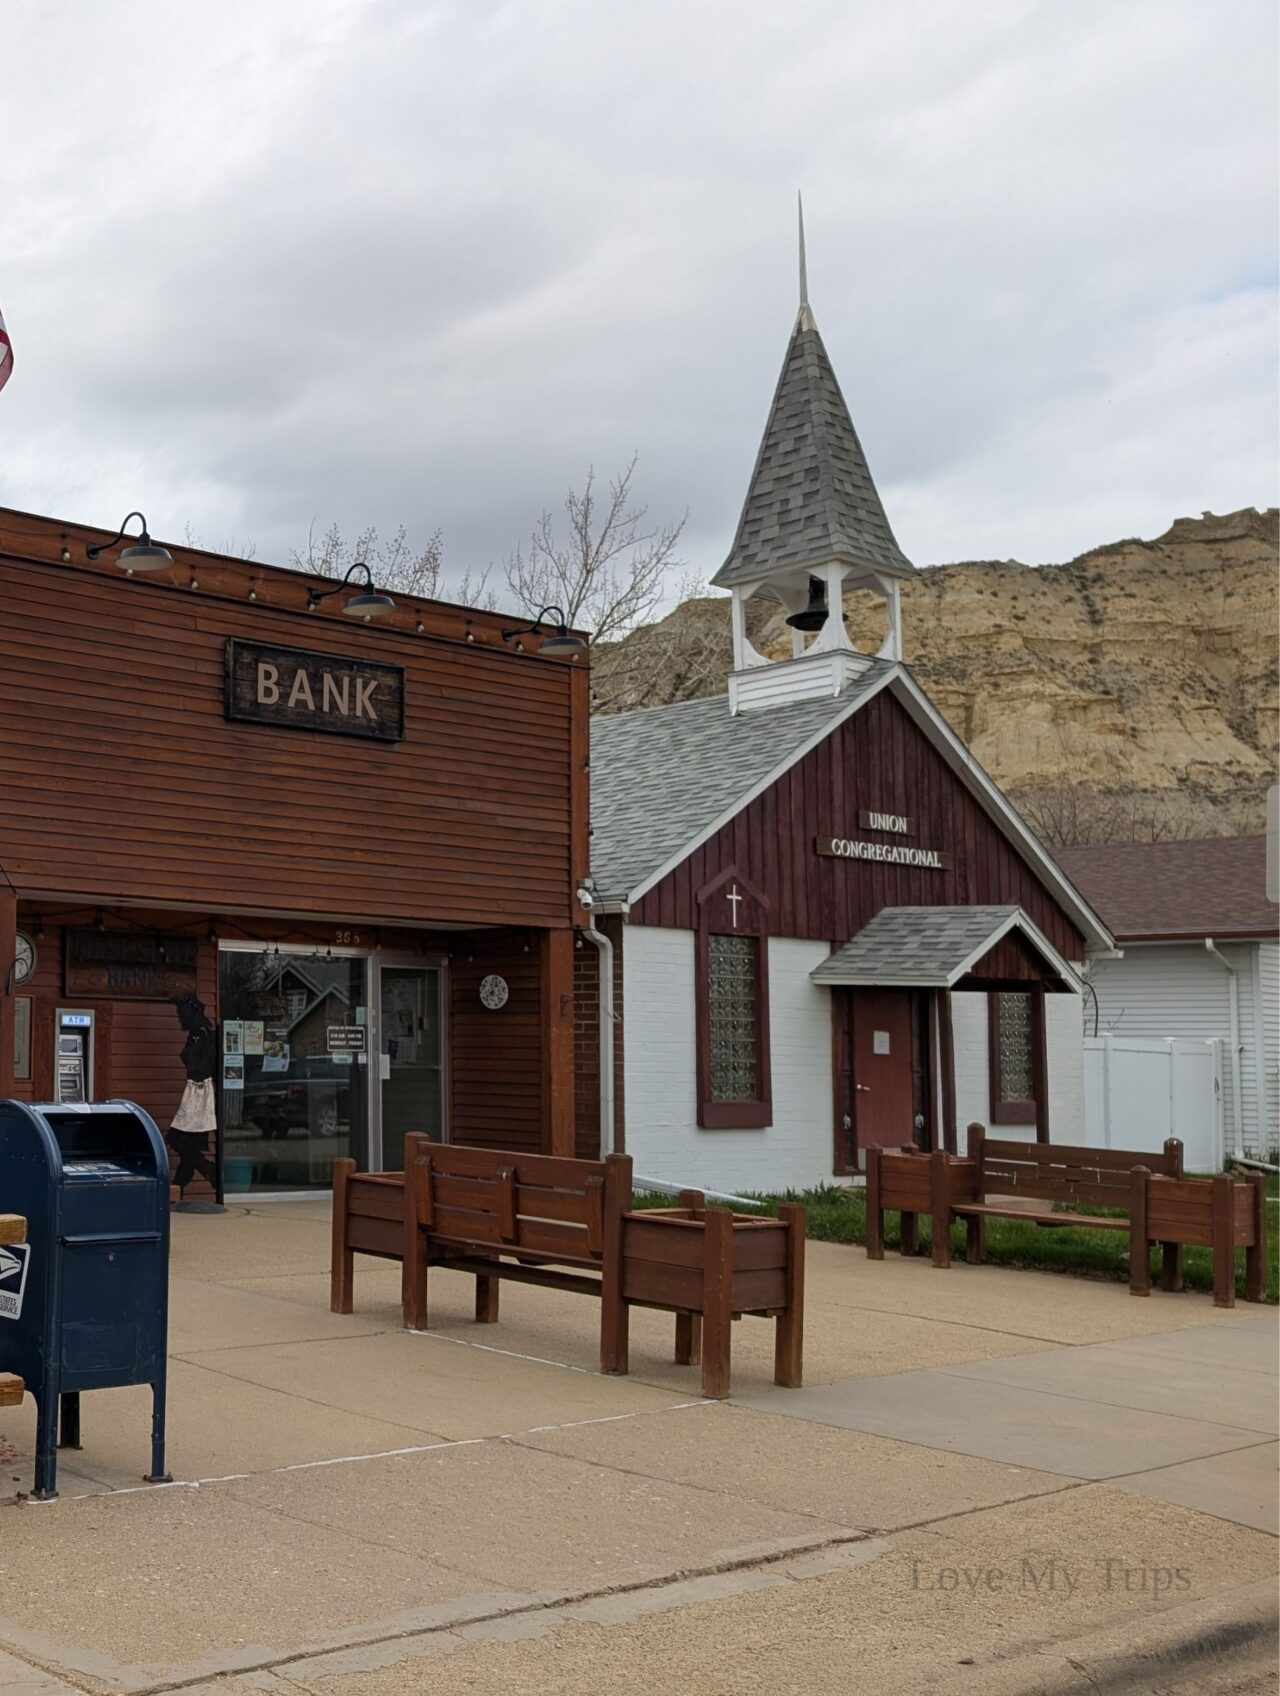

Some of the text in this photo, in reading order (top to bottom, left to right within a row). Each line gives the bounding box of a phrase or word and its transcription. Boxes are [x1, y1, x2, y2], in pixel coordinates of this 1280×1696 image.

[257, 662, 380, 721] BANK
[869, 811, 907, 833] UNION
[831, 838, 942, 868] CONGREGATIONAL
[68, 1015, 86, 1025] ATM
[0, 1294, 17, 1305] STATES
